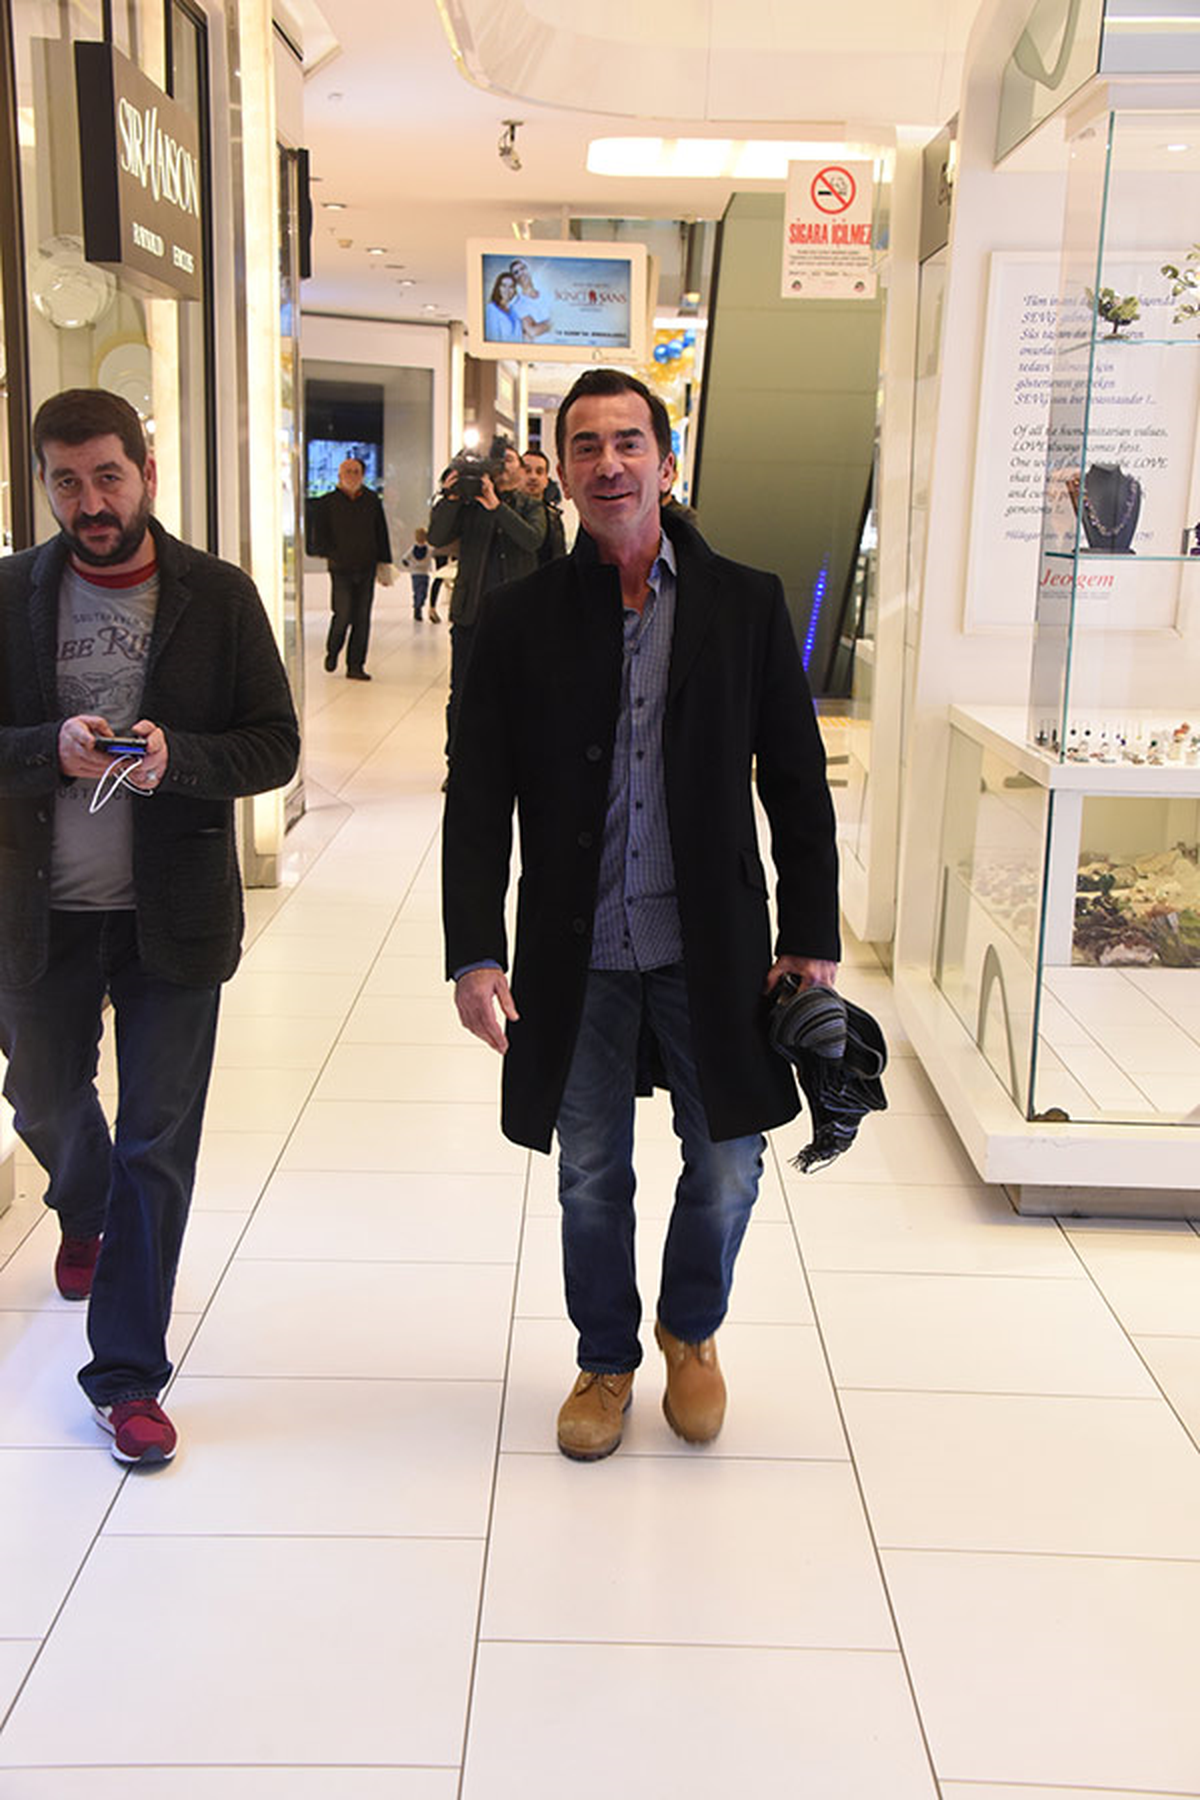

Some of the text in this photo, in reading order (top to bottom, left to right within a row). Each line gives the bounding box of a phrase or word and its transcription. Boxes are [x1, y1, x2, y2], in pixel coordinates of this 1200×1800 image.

[1013, 424, 1029, 440] Of
[1029, 424, 1044, 436] all
[1013, 440, 1046, 452] LOVE
[1011, 457, 1032, 468] One
[1134, 456, 1168, 469] LOVE
[1010, 470, 1031, 483] that
[1009, 486, 1029, 498] and
[57, 637, 95, 661] EE
